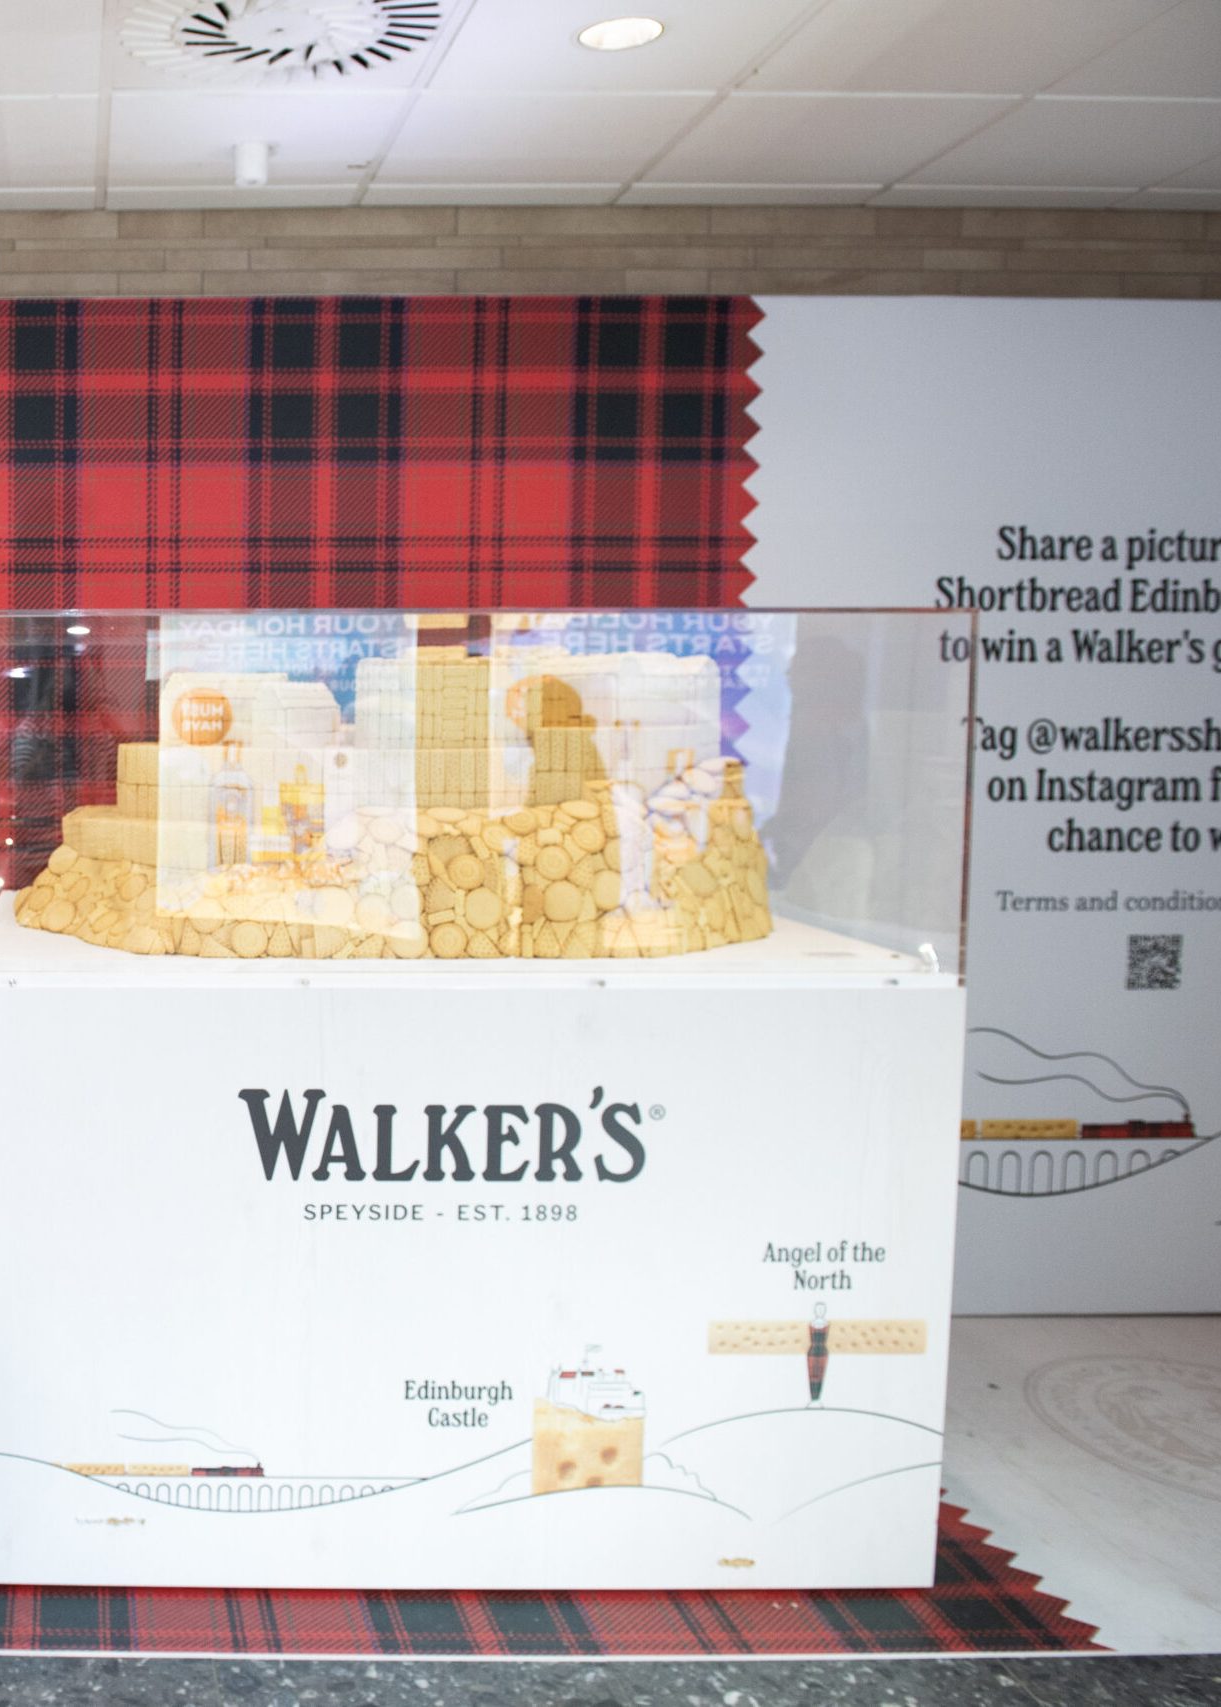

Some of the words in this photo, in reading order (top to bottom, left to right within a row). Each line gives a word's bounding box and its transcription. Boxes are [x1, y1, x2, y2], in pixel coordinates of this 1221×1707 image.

[997, 526, 1093, 561] Share
[1101, 536, 1119, 561] a
[1125, 529, 1221, 570] pictur
[936, 576, 1122, 613] Shortbread
[1130, 579, 1221, 613] Edinb
[939, 630, 971, 662] to
[981, 629, 1037, 662] win
[1046, 637, 1063, 662] a
[1071, 629, 1206, 664] Walker's
[1028, 717, 1221, 754] @walkerssh
[987, 776, 1027, 801] on
[1036, 768, 1202, 811] Instagram
[1047, 818, 1162, 852] chance
[1170, 822, 1201, 852] to
[995, 890, 1069, 912] Terms
[1075, 890, 1118, 912] and
[1125, 890, 1221, 912] conditio
[304, 1204, 423, 1221] SPEYSIDE
[457, 1205, 510, 1221] EST.
[522, 1205, 578, 1221] 1898
[763, 1242, 821, 1266] Angel
[826, 1240, 848, 1263] of
[852, 1242, 886, 1263] the
[793, 1270, 852, 1291] North
[404, 1380, 513, 1404] Edinburgh
[428, 1408, 488, 1428] Castle
